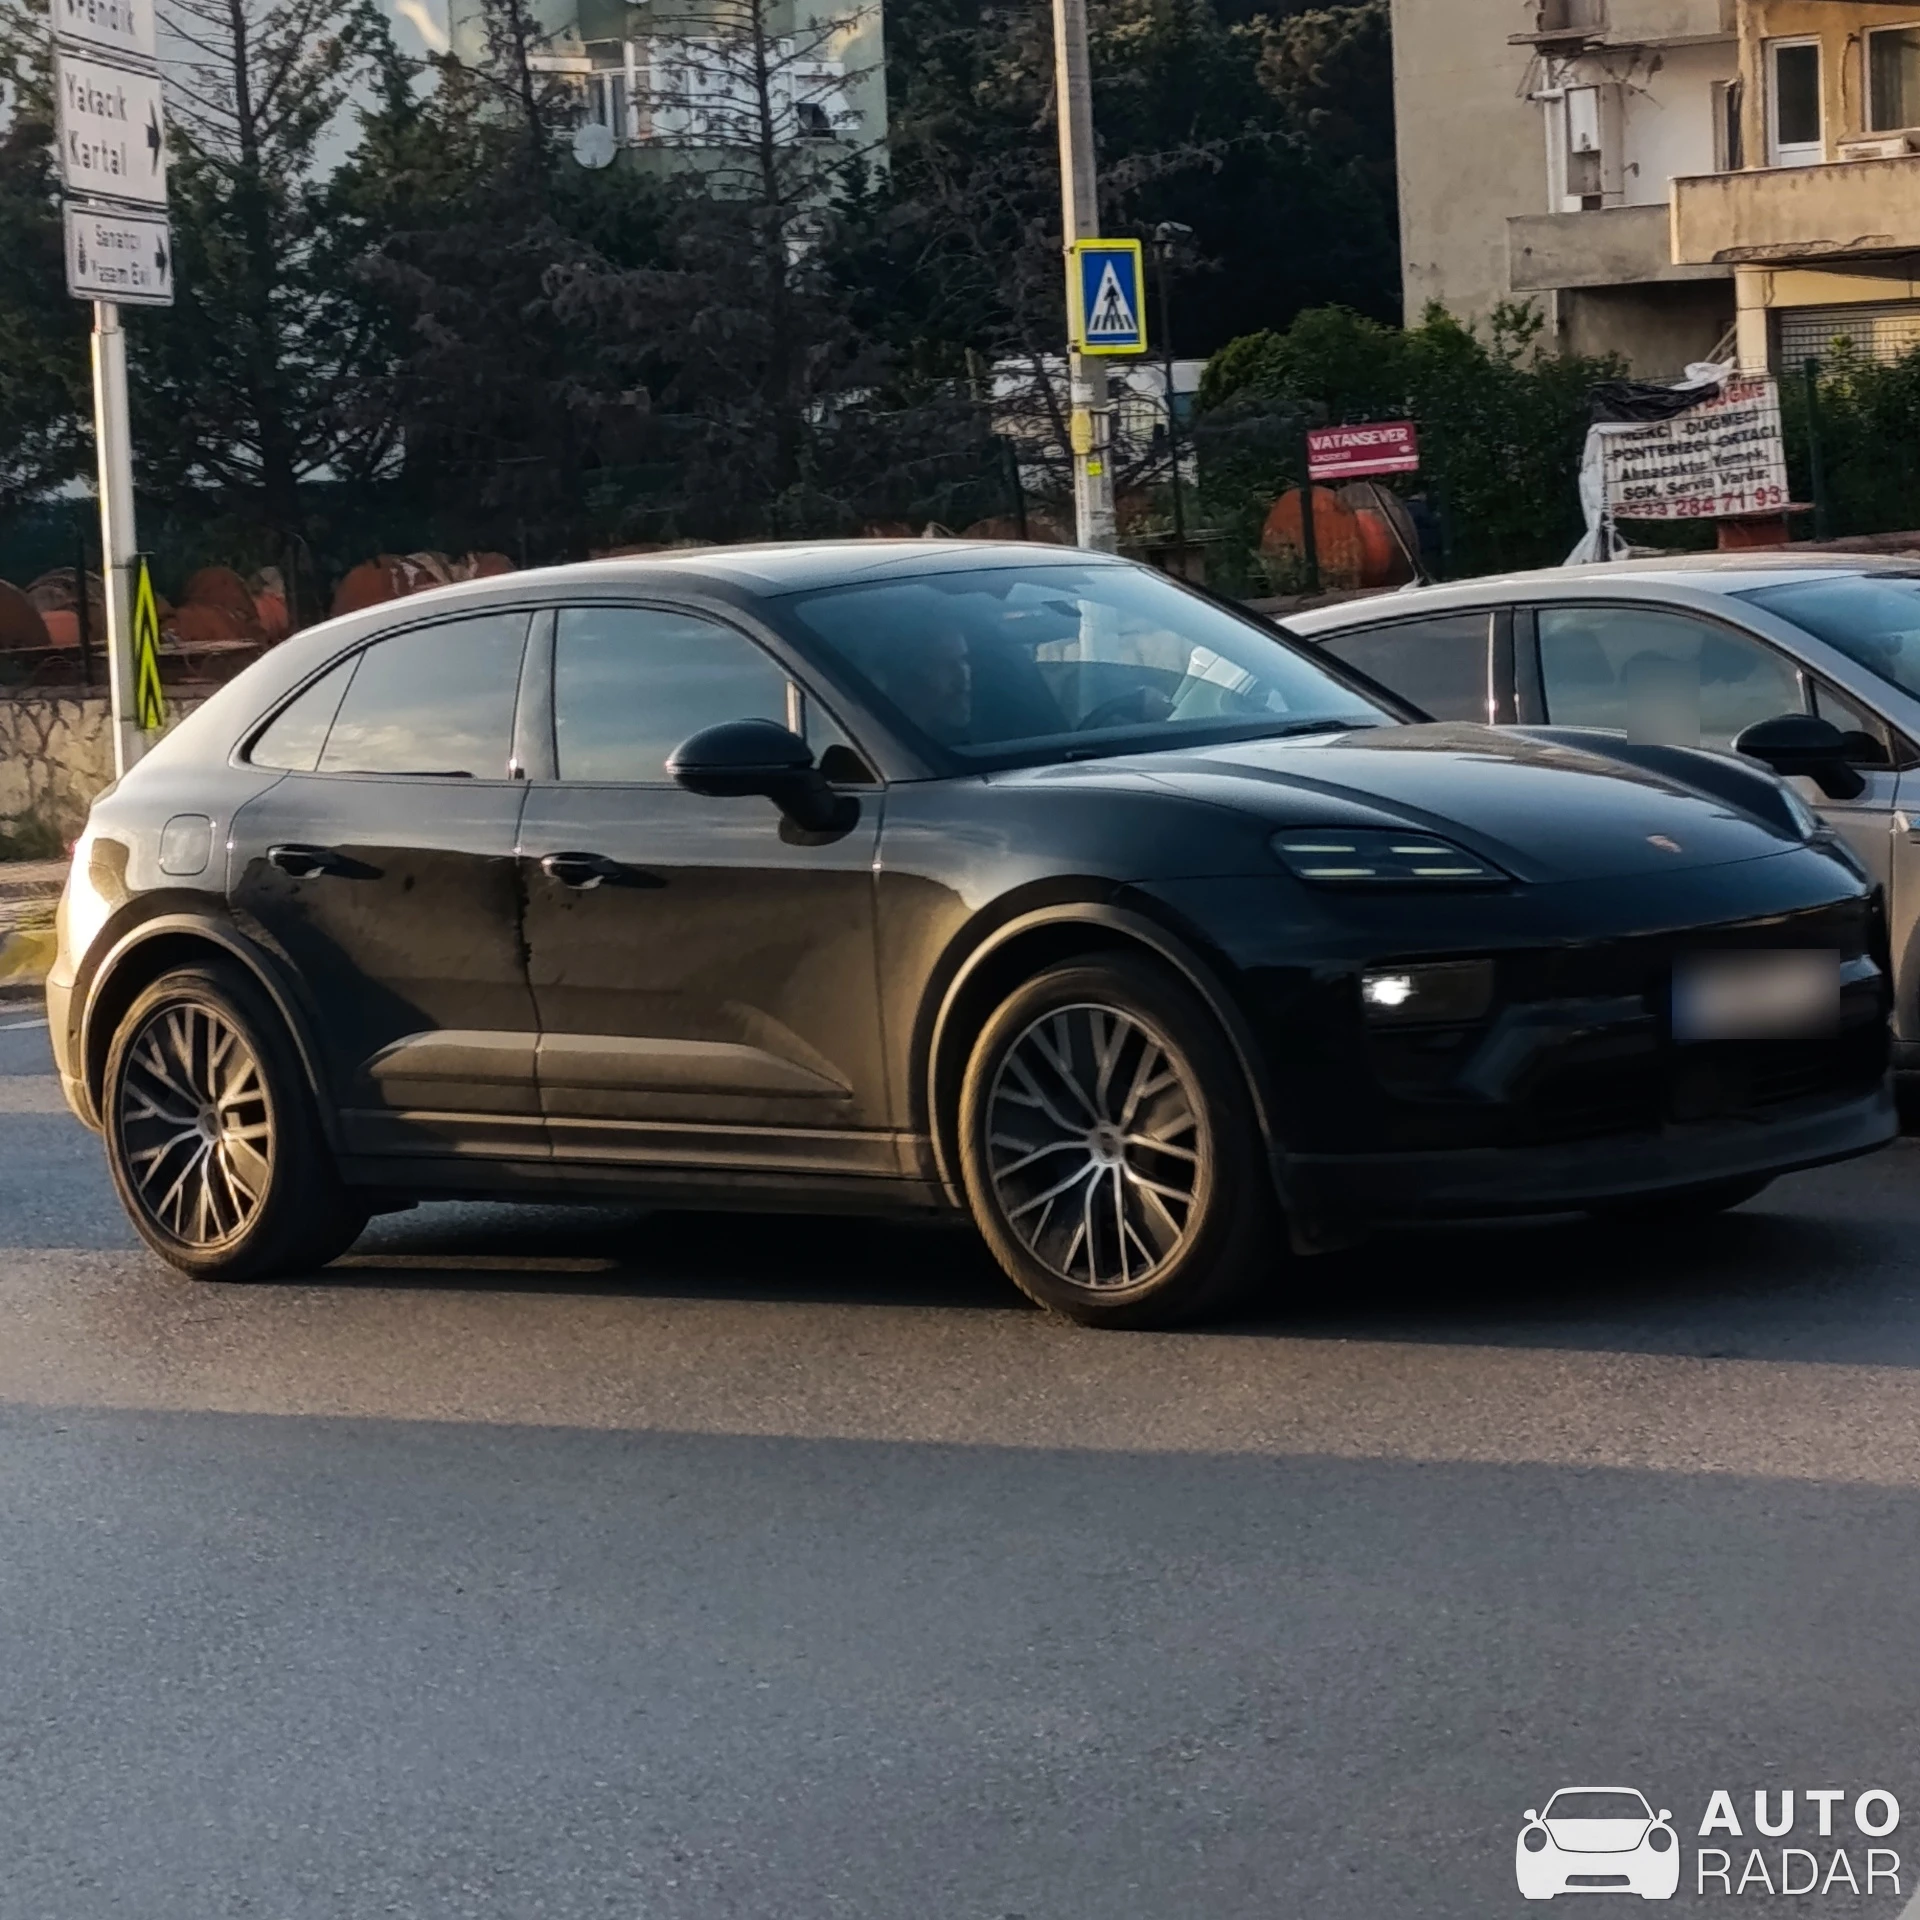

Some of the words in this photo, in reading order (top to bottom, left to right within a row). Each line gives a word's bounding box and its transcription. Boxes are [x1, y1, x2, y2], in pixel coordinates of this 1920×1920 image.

[68, 130, 127, 177] Kartal
[1308, 428, 1408, 450] VATANSEVER
[1666, 477, 1715, 496] Servis
[1675, 496, 1716, 516] 284
[1720, 490, 1746, 511] 71
[1755, 485, 1782, 507] 93
